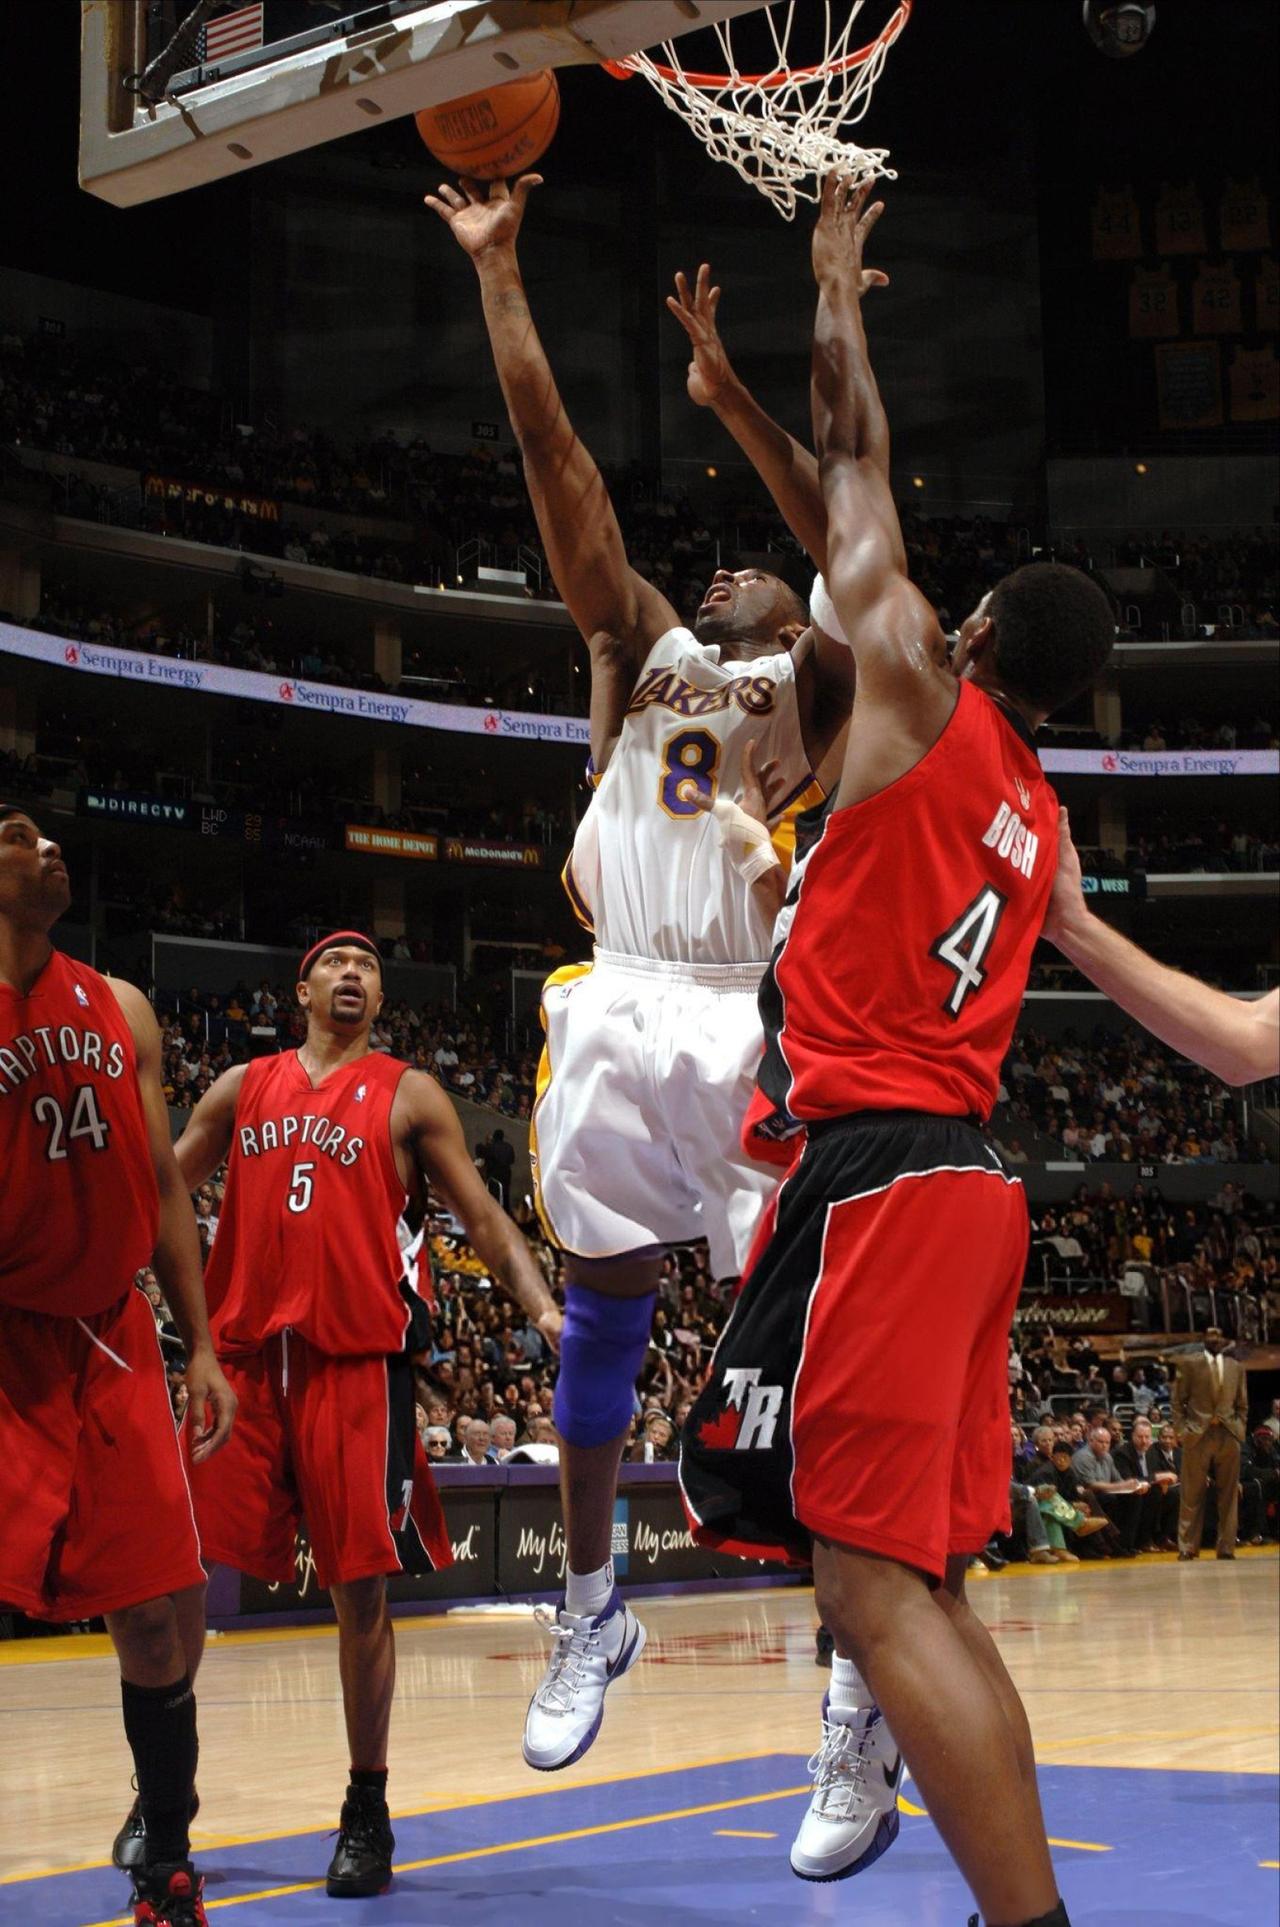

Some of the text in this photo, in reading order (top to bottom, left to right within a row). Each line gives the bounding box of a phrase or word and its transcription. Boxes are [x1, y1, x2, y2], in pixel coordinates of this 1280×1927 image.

[81, 648, 204, 687] Sempra Energy
[297, 686, 409, 723] Sempra Energy
[502, 716, 591, 740] Sempra Ene
[657, 727, 722, 821] 8
[1120, 756, 1239, 775] Sempra Energy
[348, 831, 435, 855] THE HOME DEPOT
[464, 845, 523, 861] McDonald's
[981, 800, 1039, 880] BOSH
[1101, 877, 1129, 892] WEST
[929, 881, 1008, 1019] 4
[0, 1025, 124, 1094] APTORS
[34, 1085, 110, 1161] 24
[239, 1115, 364, 1167] RAPTORS
[287, 1161, 316, 1213] 5
[516, 1527, 546, 1574] My
[634, 1520, 660, 1564] My
